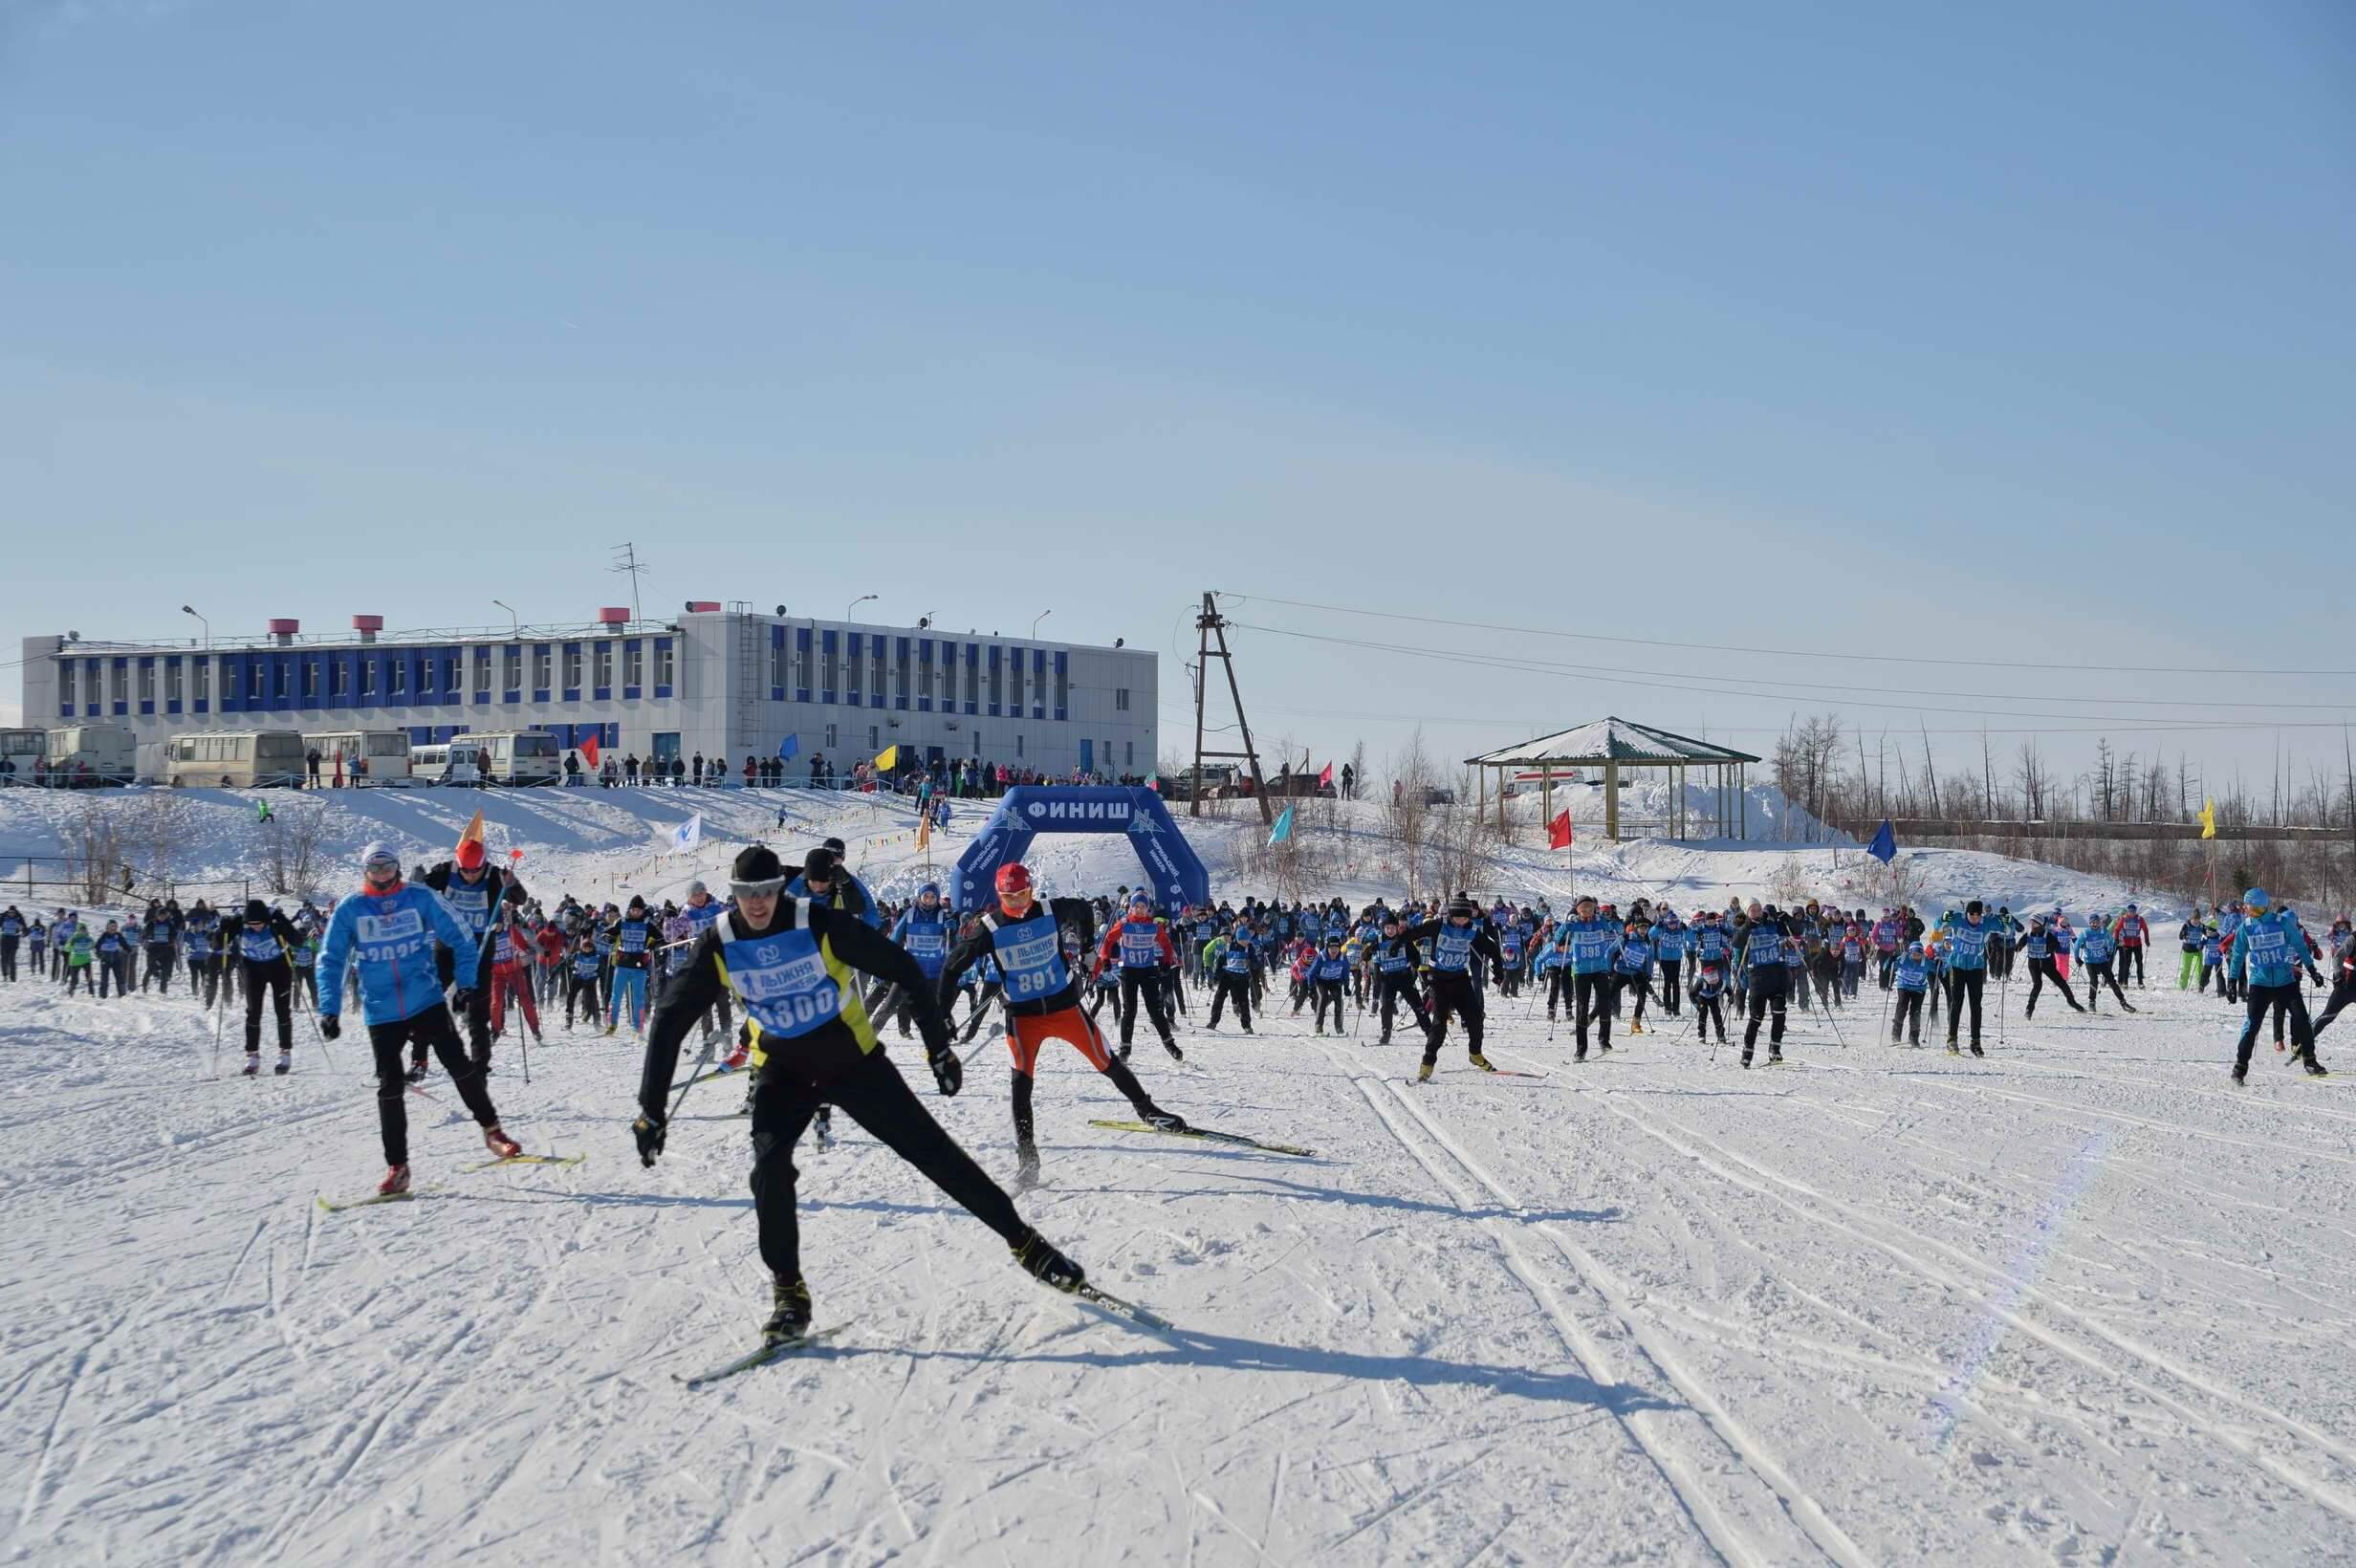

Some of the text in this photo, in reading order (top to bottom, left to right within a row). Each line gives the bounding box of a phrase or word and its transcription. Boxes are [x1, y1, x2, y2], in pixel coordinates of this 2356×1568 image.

[1027, 801, 1129, 819] ФИНИШ
[967, 834, 1000, 874] НОРИЛЬСКИЙ
[978, 847, 1000, 871] НИКЕЛЬ
[761, 961, 815, 988] ЛЫЖНЯ
[1017, 964, 1057, 993] 891
